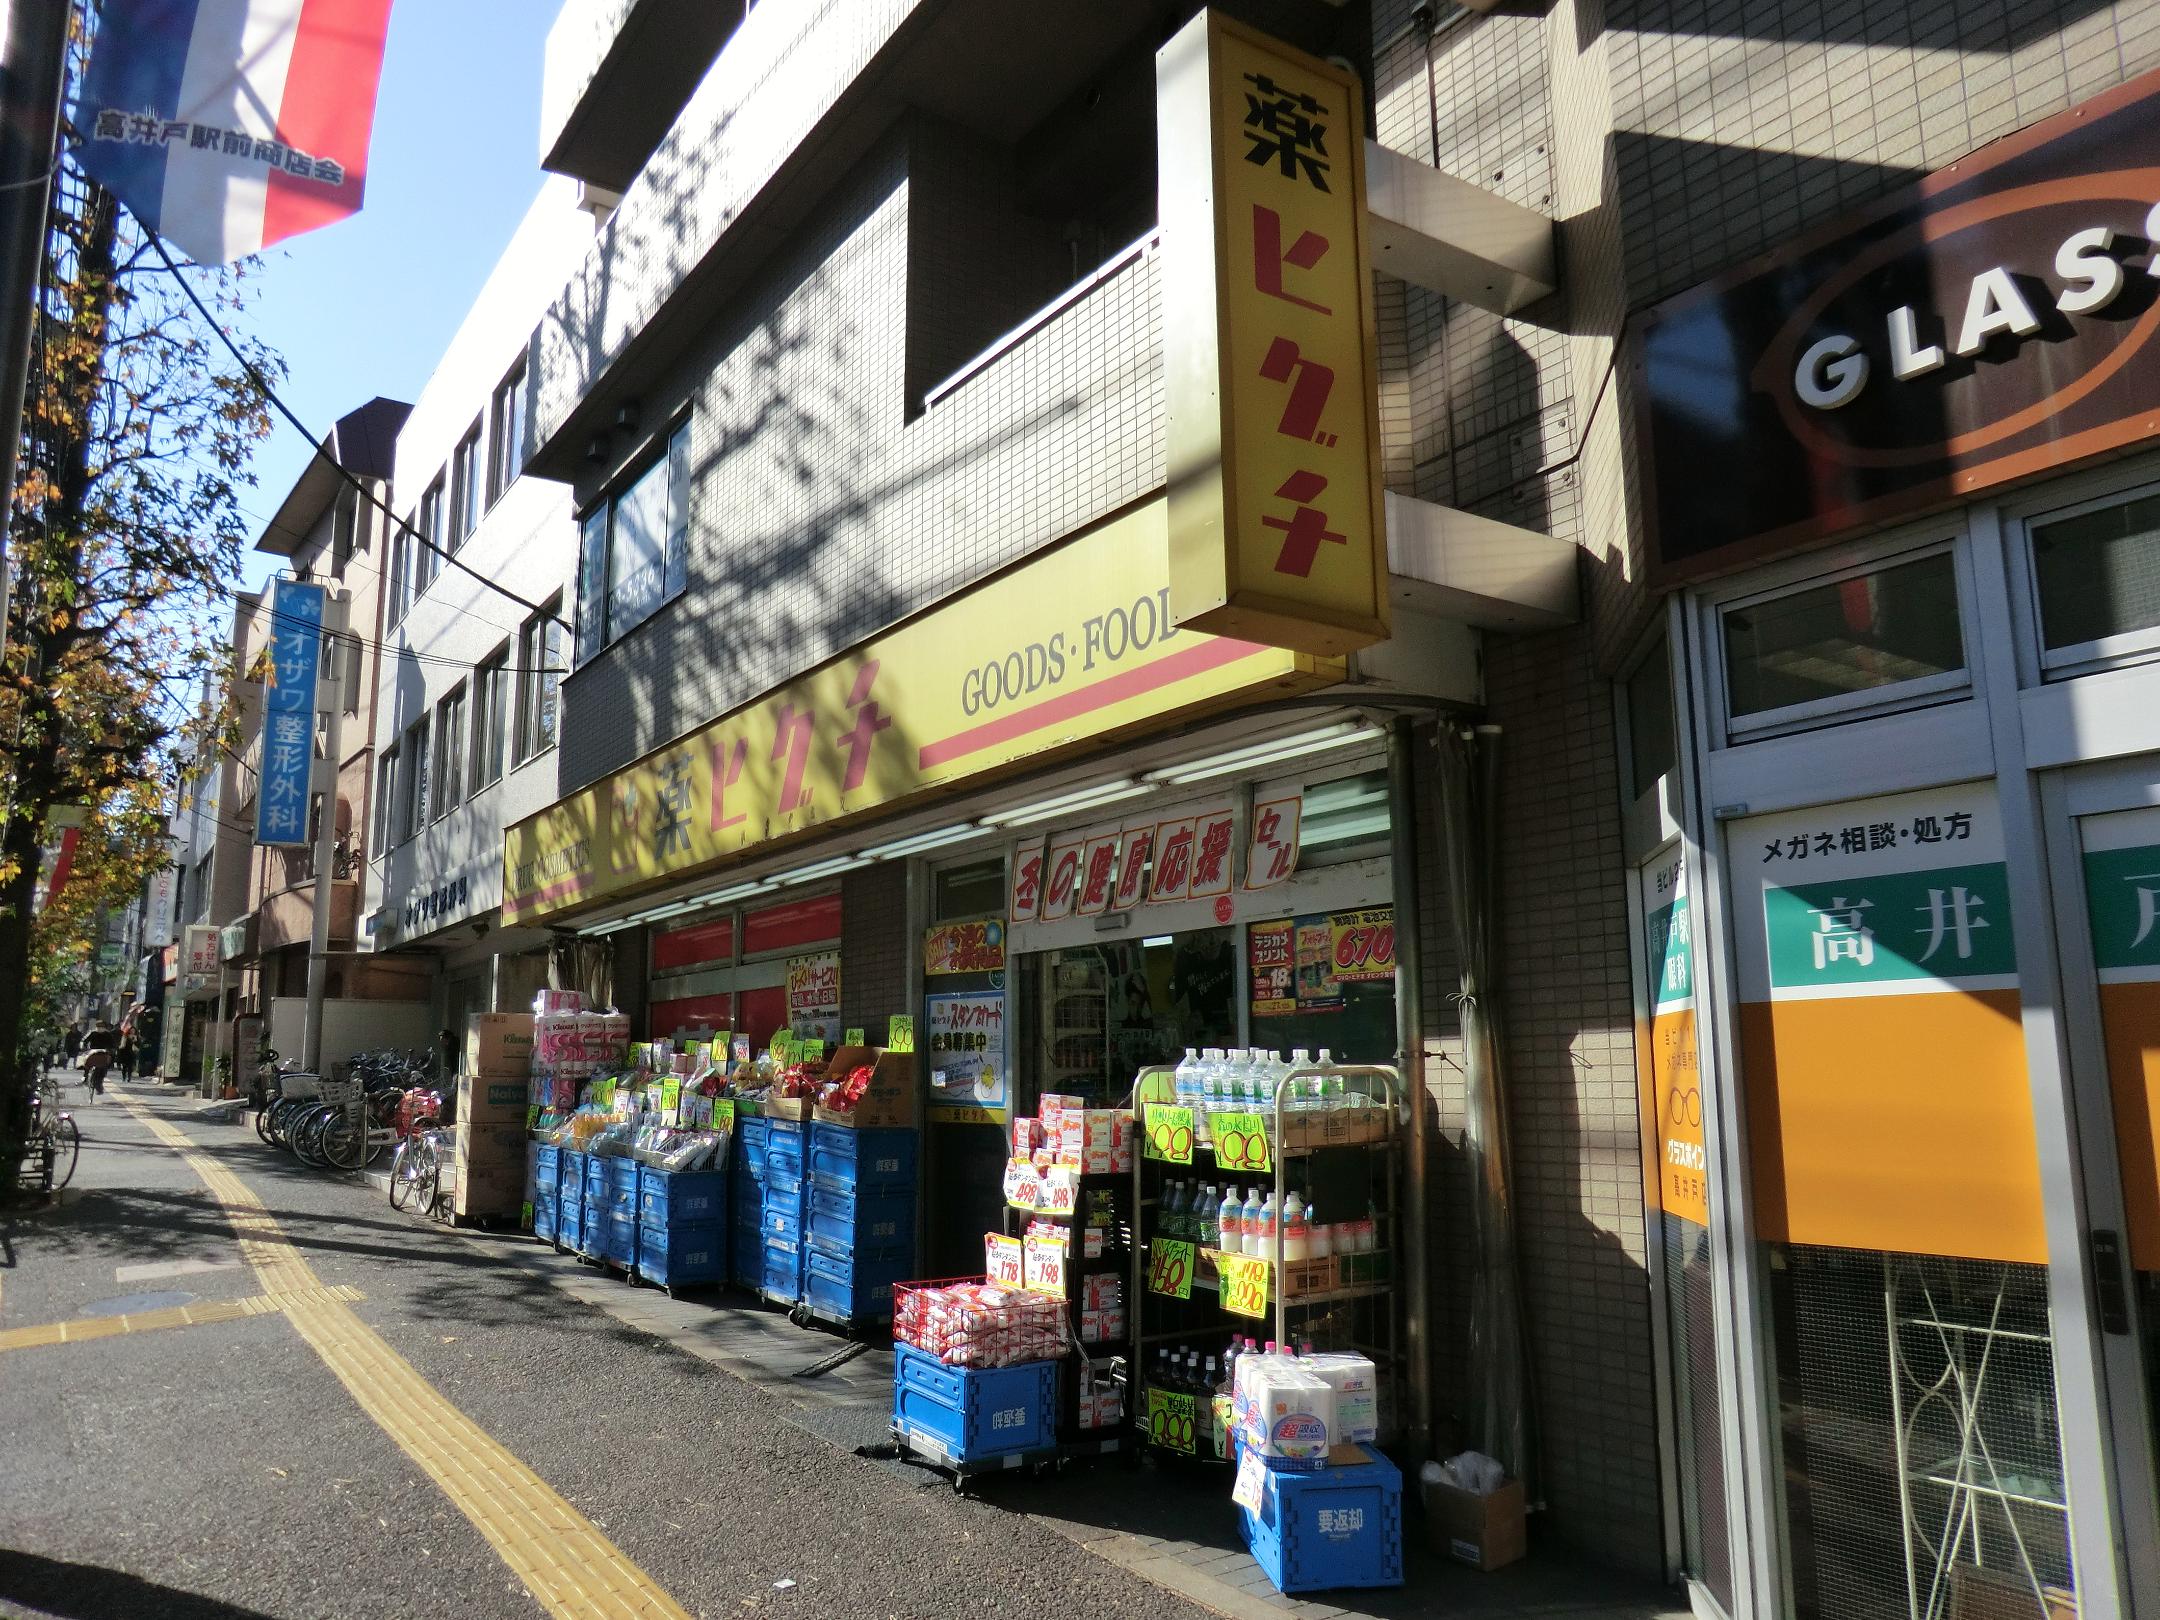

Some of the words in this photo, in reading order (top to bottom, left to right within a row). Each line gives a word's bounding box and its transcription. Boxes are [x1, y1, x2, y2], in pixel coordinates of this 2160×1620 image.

[94, 108, 345, 186] 高井戸駅前商店会
[1795, 198, 2160, 410] GLAS
[1243, 71, 1348, 579] 薬ヒグチ
[267, 628, 314, 835] オザワ整形外科
[654, 657, 892, 861] 薬ヒグチ
[1762, 811, 1973, 864] メガネ相談・処方
[1014, 817, 1233, 910] 冬の健康応援
[1257, 806, 1291, 880] セール
[203, 932, 217, 970] 処方せん
[1254, 931, 1289, 948] デジカメ
[1254, 948, 1289, 963] プリント
[1666, 952, 1687, 992] 眼科
[931, 1031, 987, 1053] 会員募集中
[1015, 1182, 1038, 1204] 498
[1052, 1187, 1069, 1208] 498
[1000, 1260, 1019, 1282] 178
[1040, 1263, 1059, 1285] 198
[991, 1406, 1027, 1431] 要返却
[1278, 1424, 1321, 1440] 超吸収
[1318, 1507, 1364, 1534] 要返却
